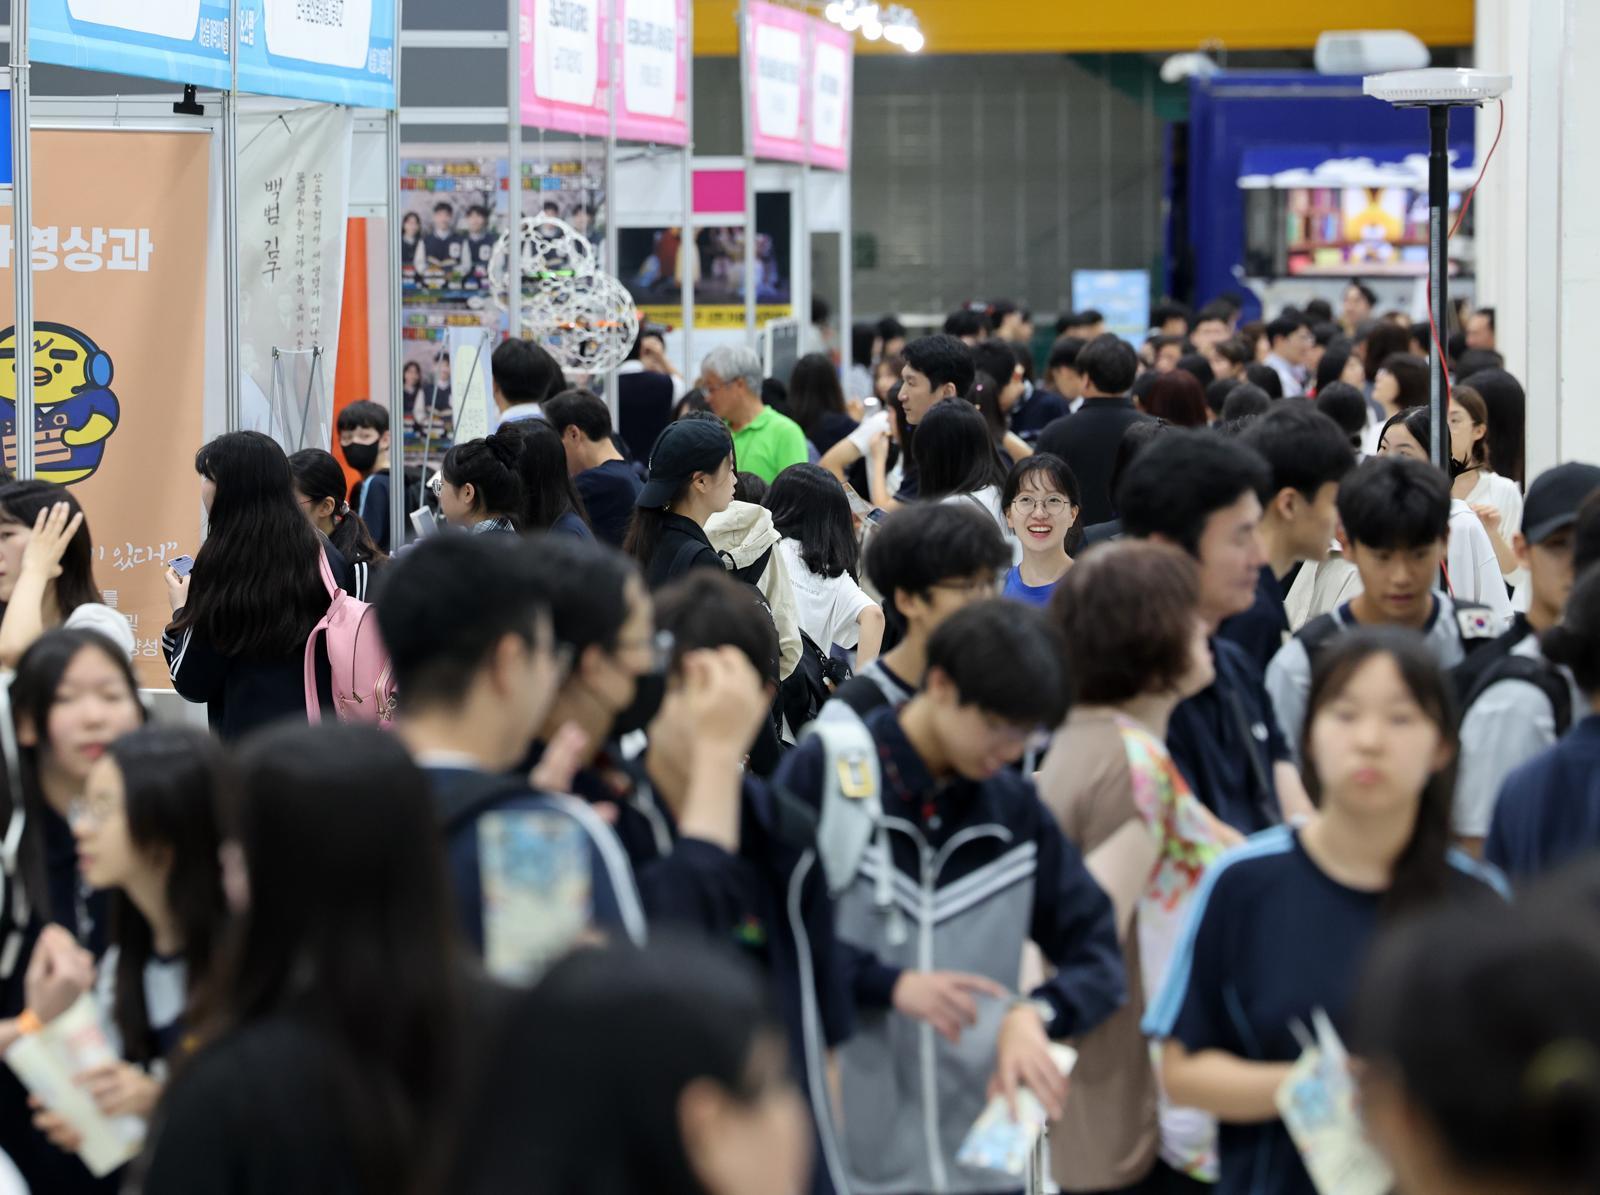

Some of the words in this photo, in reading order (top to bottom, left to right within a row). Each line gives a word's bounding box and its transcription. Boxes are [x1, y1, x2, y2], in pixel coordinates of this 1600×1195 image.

[263, 176, 283, 226] 백범
[0, 223, 154, 273] 영상과
[261, 235, 281, 284] 김구
